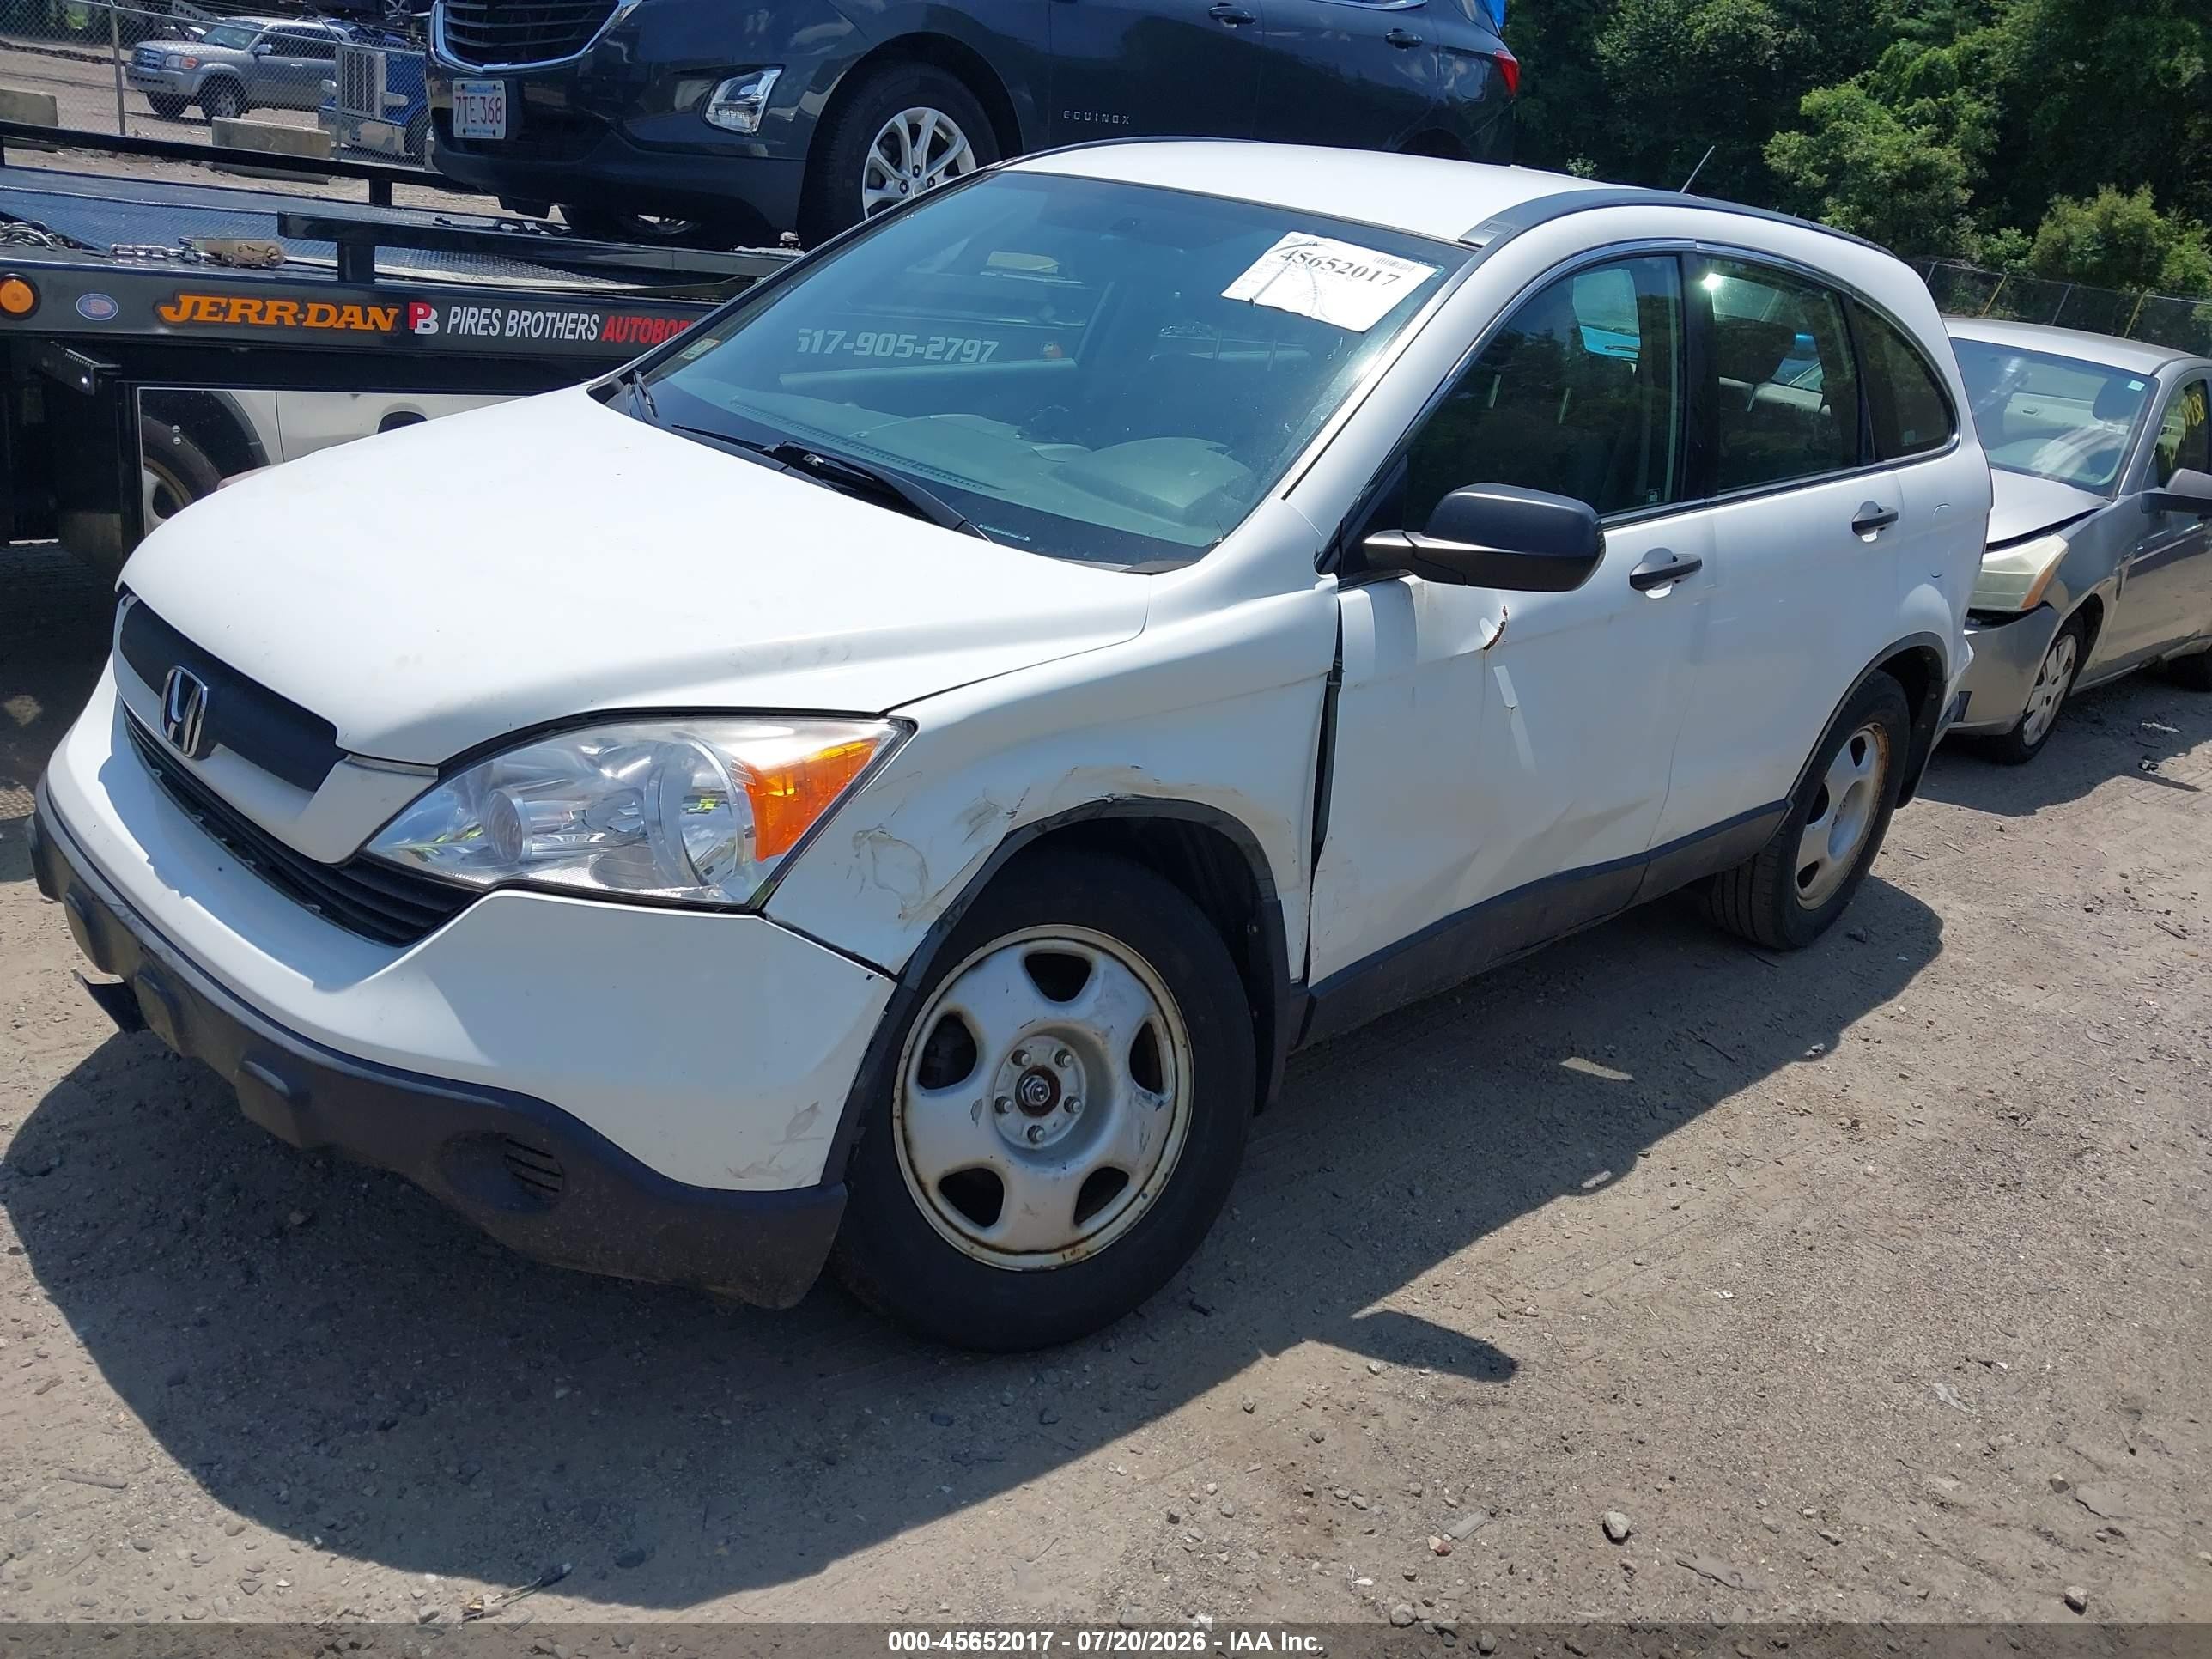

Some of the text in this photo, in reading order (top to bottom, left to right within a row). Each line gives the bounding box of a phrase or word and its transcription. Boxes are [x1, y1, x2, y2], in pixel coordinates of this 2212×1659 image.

[455, 96, 502, 124] 7TE 368
[1063, 110, 1130, 125] EQUINOX
[1279, 249, 1403, 287] 45652017
[447, 306, 695, 343] PIRES BROTHERS AUTOBO
